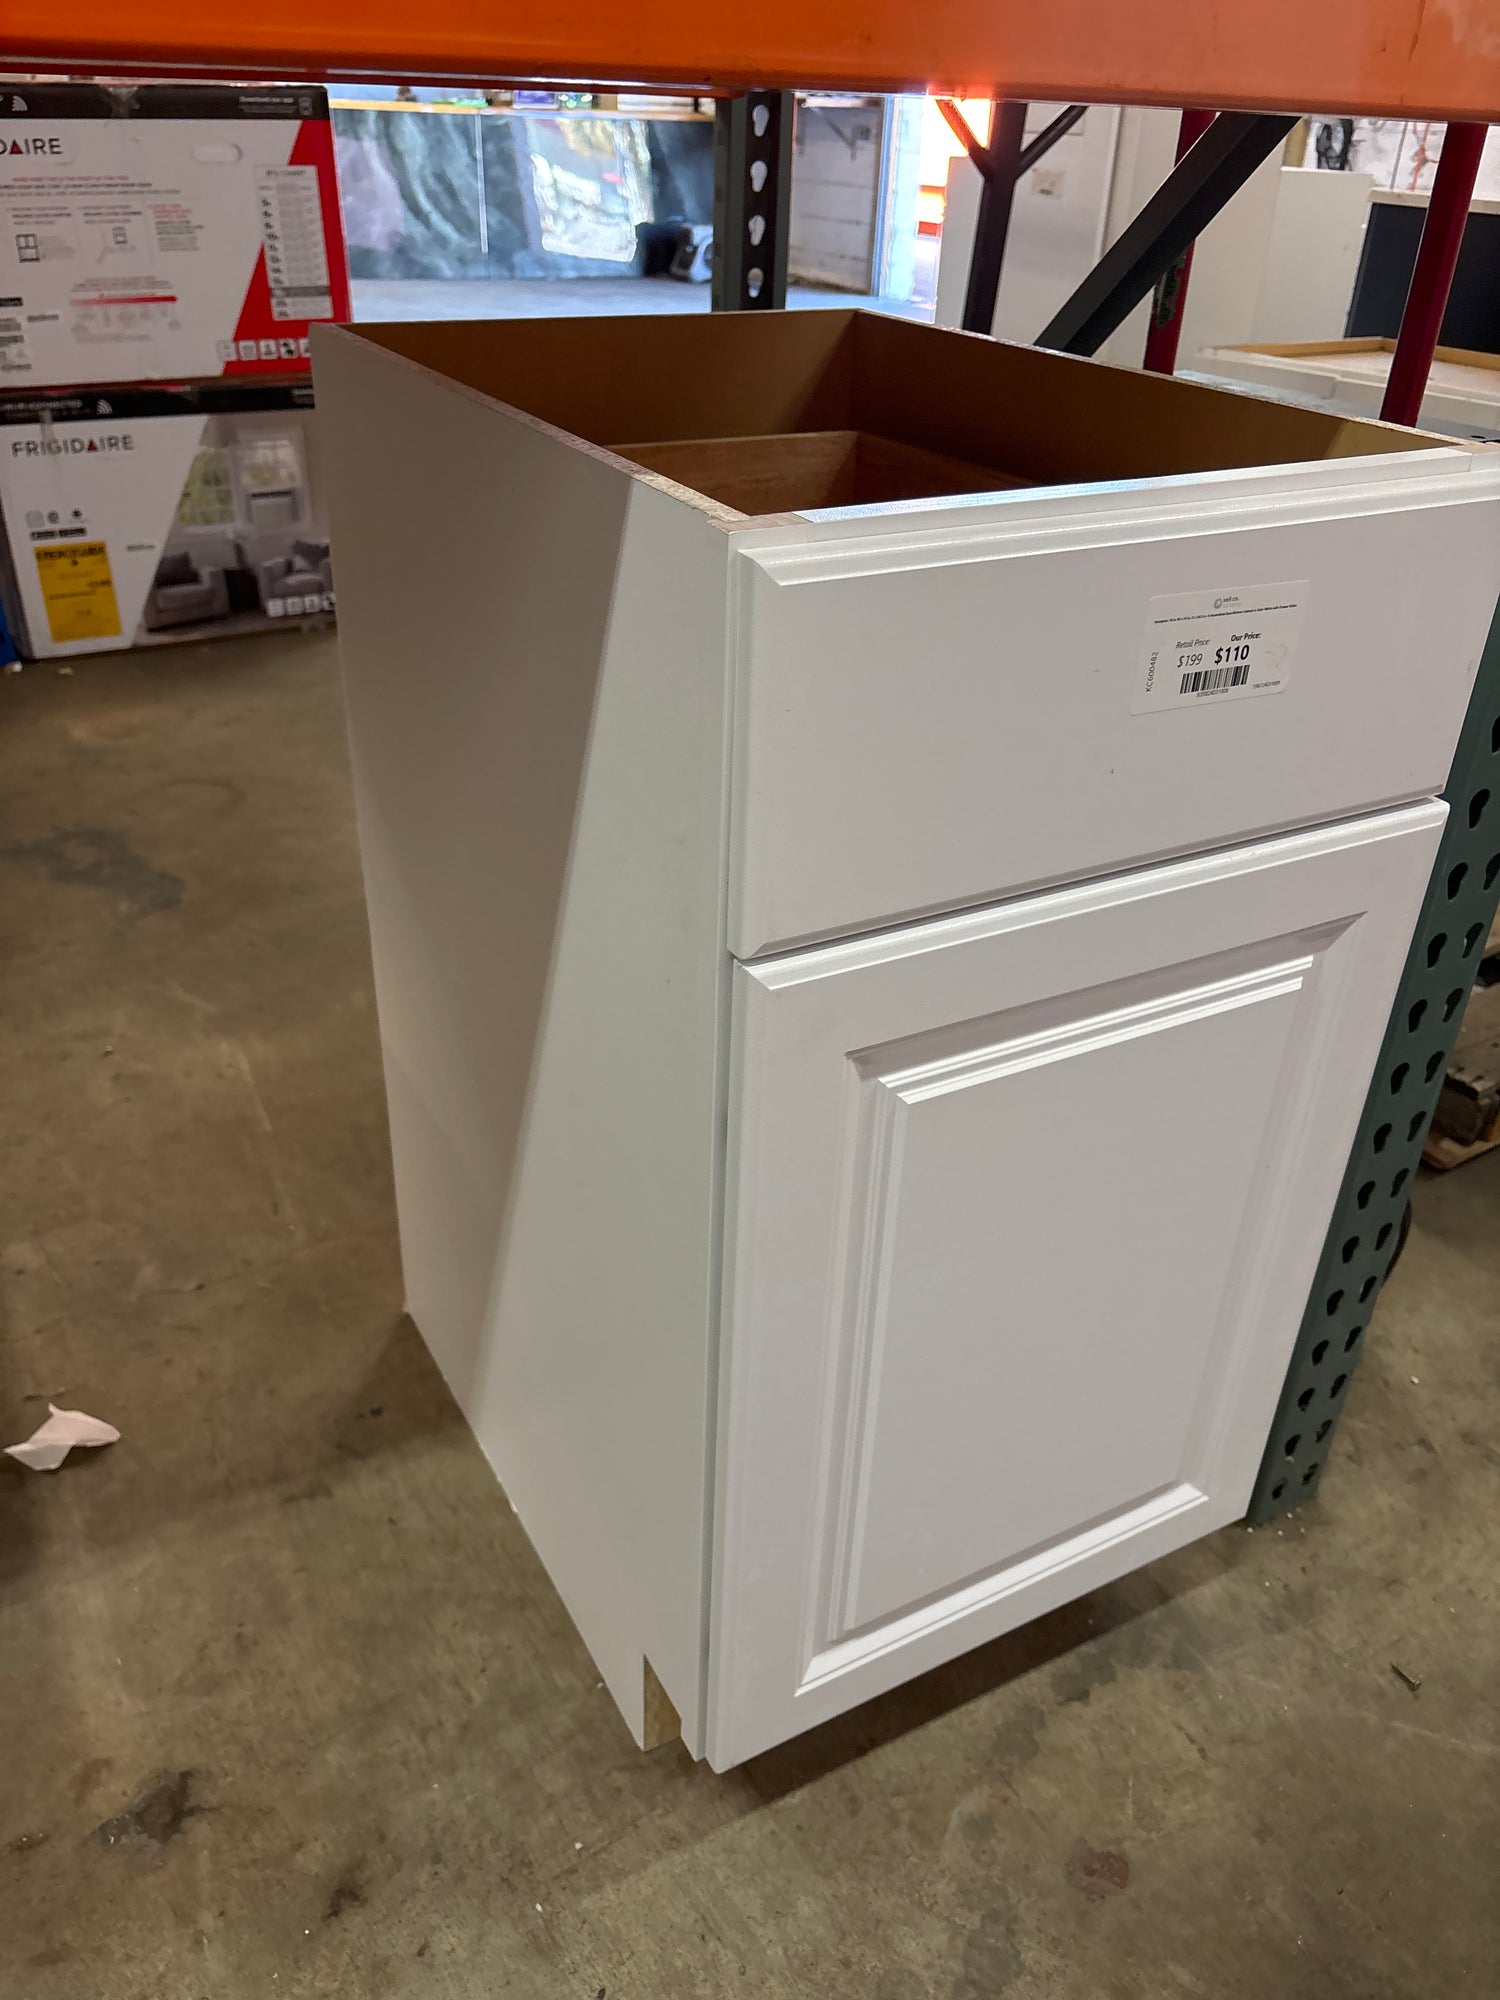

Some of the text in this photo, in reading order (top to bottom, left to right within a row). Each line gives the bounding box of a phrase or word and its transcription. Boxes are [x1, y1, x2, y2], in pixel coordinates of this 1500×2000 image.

[11, 434, 134, 458] FRIGIDAIRE
[1175, 640, 1193, 649] Retail
[1231, 632, 1262, 642] Our Price:
[1177, 653, 1203, 668] $199
[1215, 644, 1250, 666] $110
[1145, 651, 1159, 692] KC600482
